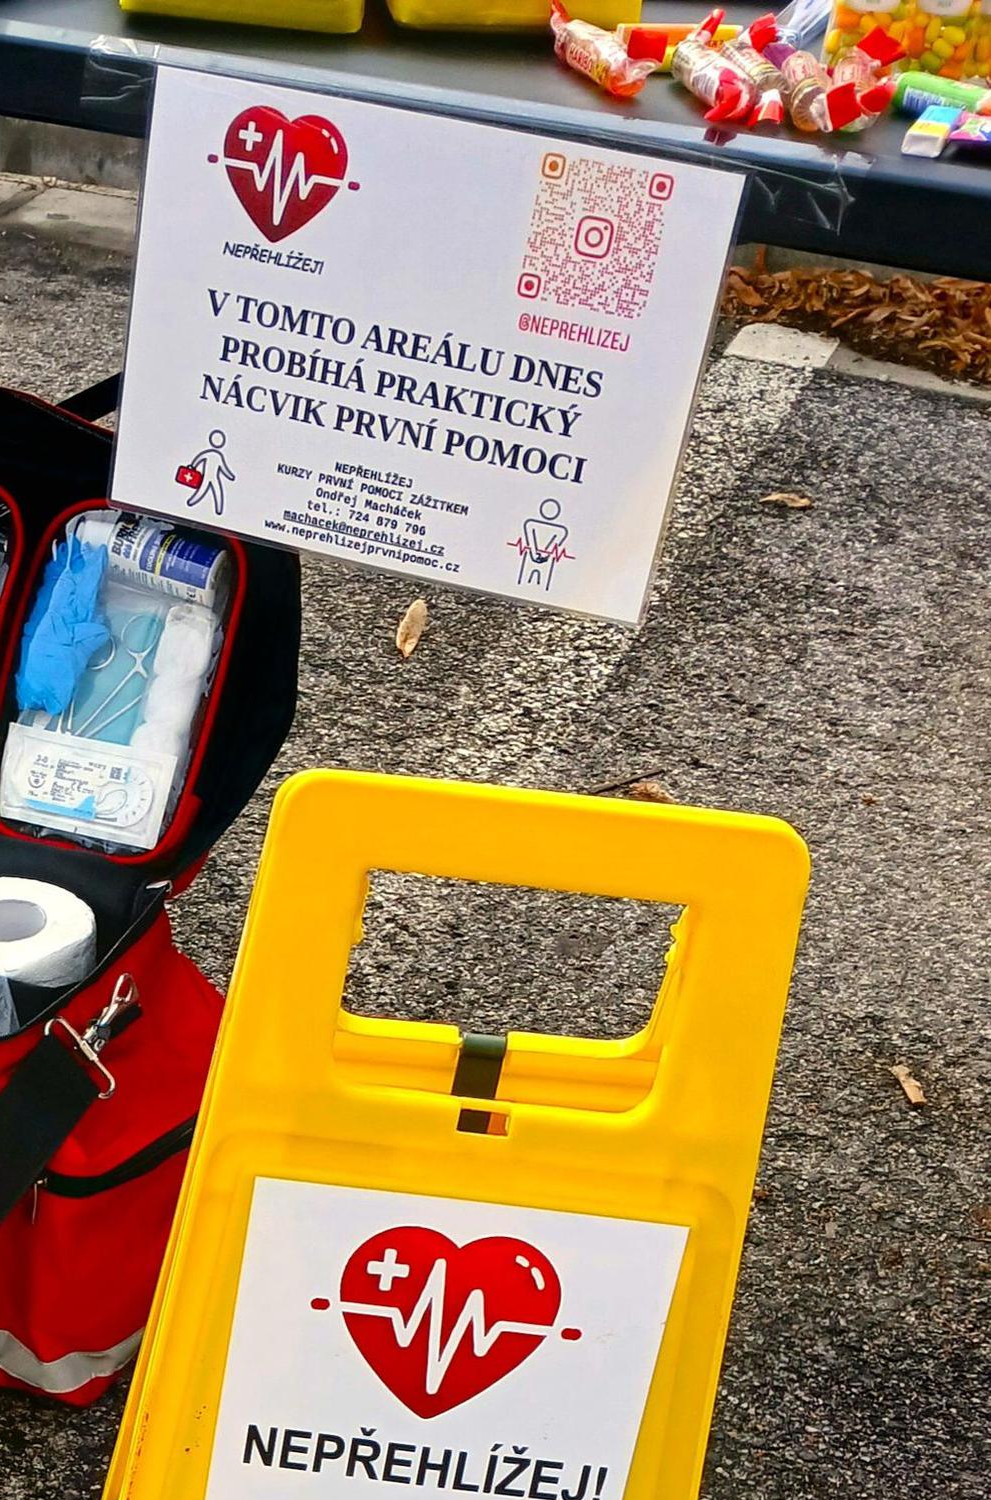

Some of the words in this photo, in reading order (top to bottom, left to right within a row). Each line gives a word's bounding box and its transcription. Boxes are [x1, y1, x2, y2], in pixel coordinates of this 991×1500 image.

[222, 240, 324, 275] NEPŘEHLÍŽEJ!
[207, 288, 232, 318] V
[235, 294, 357, 346] TOMTO
[361, 323, 504, 378] AREÁLU
[510, 354, 604, 399] DNES
[517, 312, 631, 353] @NEPREHLIZEJ
[220, 335, 366, 393] PROBÍHÁ
[374, 369, 582, 438] PRAKTICKÝ
[199, 373, 325, 427] NÁCVIK
[334, 407, 437, 454] PRVNÍ
[442, 429, 588, 484] POMOCI
[276, 463, 312, 480] KURZY
[318, 473, 353, 490] PRVNÍ
[360, 482, 403, 502] POMOCI
[410, 493, 469, 516] ZÁŽITKEM
[334, 461, 413, 489] NEPŘEHLÍŽEJ
[307, 500, 341, 517] tel.:
[348, 508, 370, 523] 724
[376, 516, 398, 530] 879
[405, 522, 426, 536] 796
[315, 487, 358, 508] Ondřej
[364, 499, 421, 520] Macháček
[264, 519, 460, 573] www.neprehlizejprvnipomoc.cz
[283, 509, 445, 556] machacek@neprehlizej.cz
